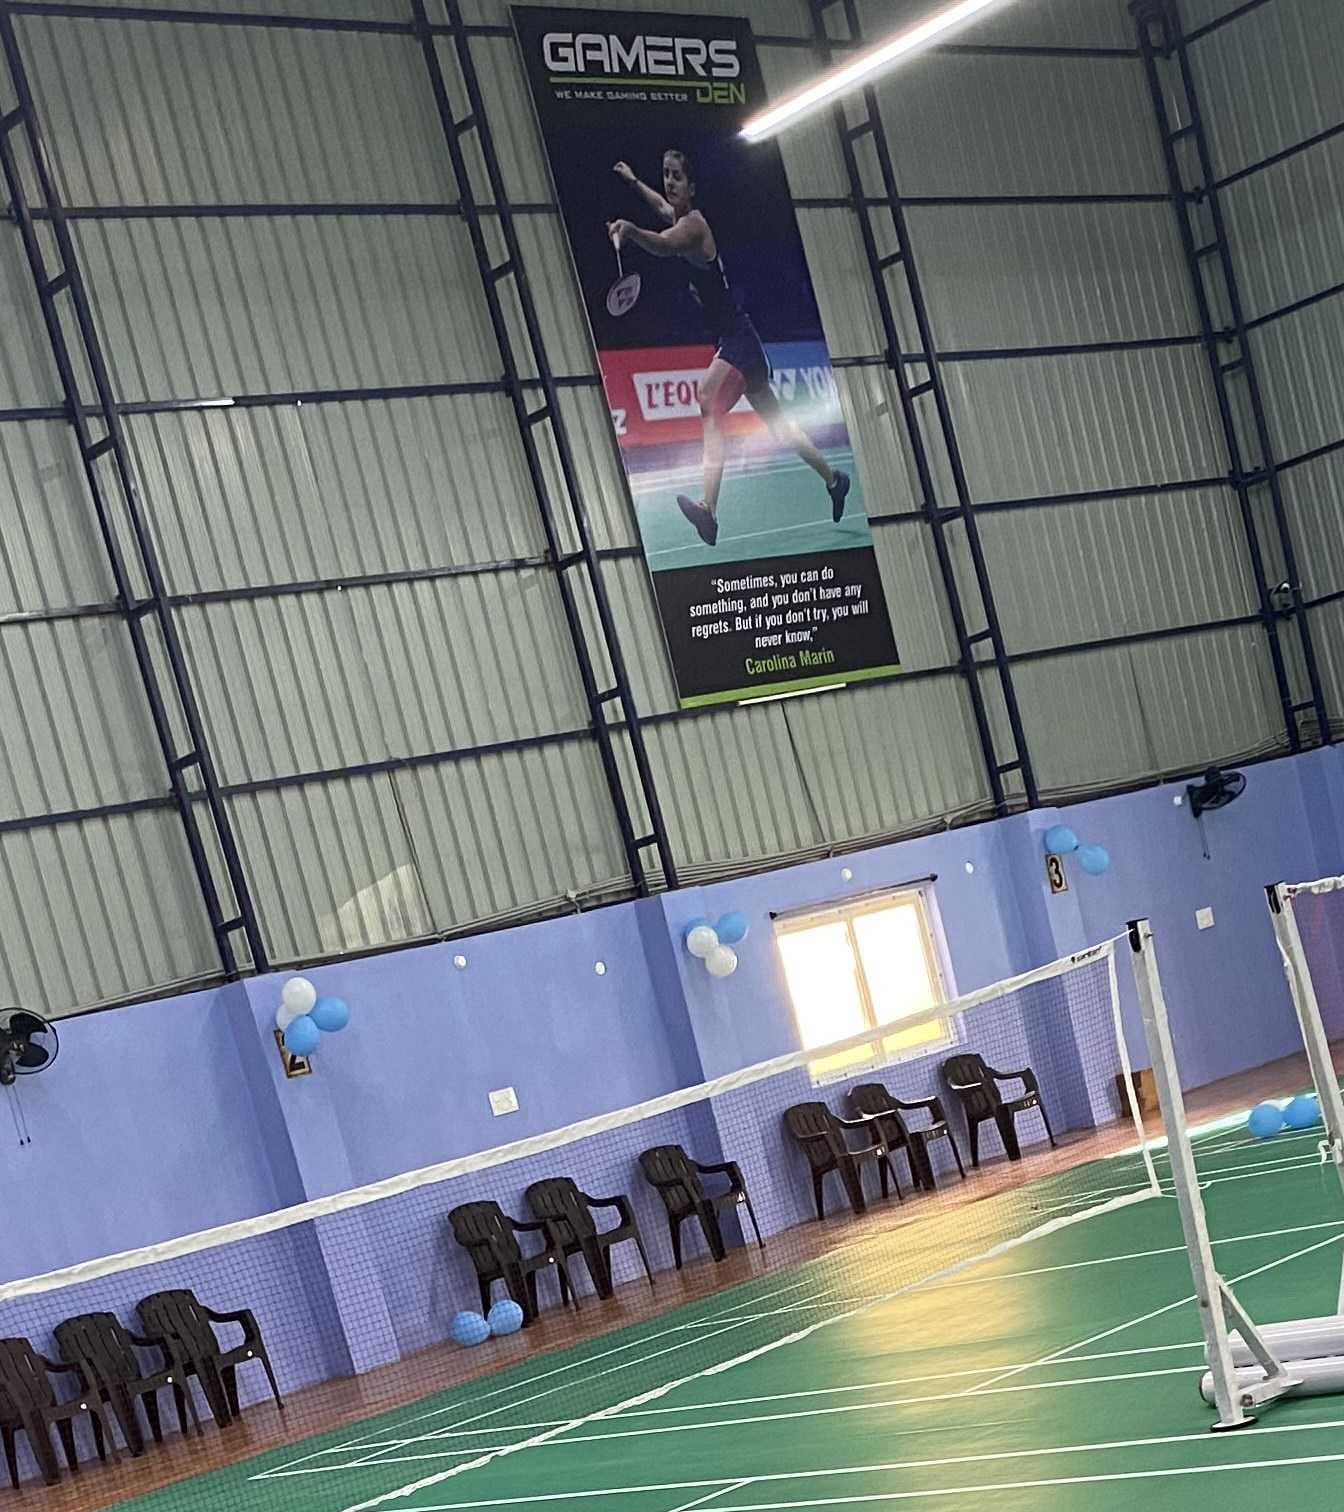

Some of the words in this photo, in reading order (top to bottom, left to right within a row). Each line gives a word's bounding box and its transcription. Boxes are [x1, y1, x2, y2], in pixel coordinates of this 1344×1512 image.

[542, 33, 740, 77] GAMERS
[556, 90, 572, 99] WE
[575, 90, 603, 100] MAKE
[607, 91, 647, 101] GAMING
[651, 92, 688, 102] BETTER
[696, 81, 746, 104] DEN
[780, 572, 798, 589] you
[800, 569, 819, 583] can
[821, 566, 834, 580] do
[690, 598, 747, 617] something,
[750, 595, 769, 609] and
[772, 592, 790, 609] you
[792, 588, 817, 602] don't
[819, 586, 842, 598] have
[844, 584, 862, 598] any
[691, 620, 733, 639] regrets.
[735, 617, 753, 631] But
[755, 614, 763, 629] if
[765, 613, 783, 630] you
[786, 609, 811, 624] don't
[831, 605, 849, 620] you
[851, 600, 869, 615] will
[755, 634, 782, 648] never
[745, 654, 797, 675] Carolina
[800, 647, 835, 668] Marin
[1049, 856, 1063, 888] 3
